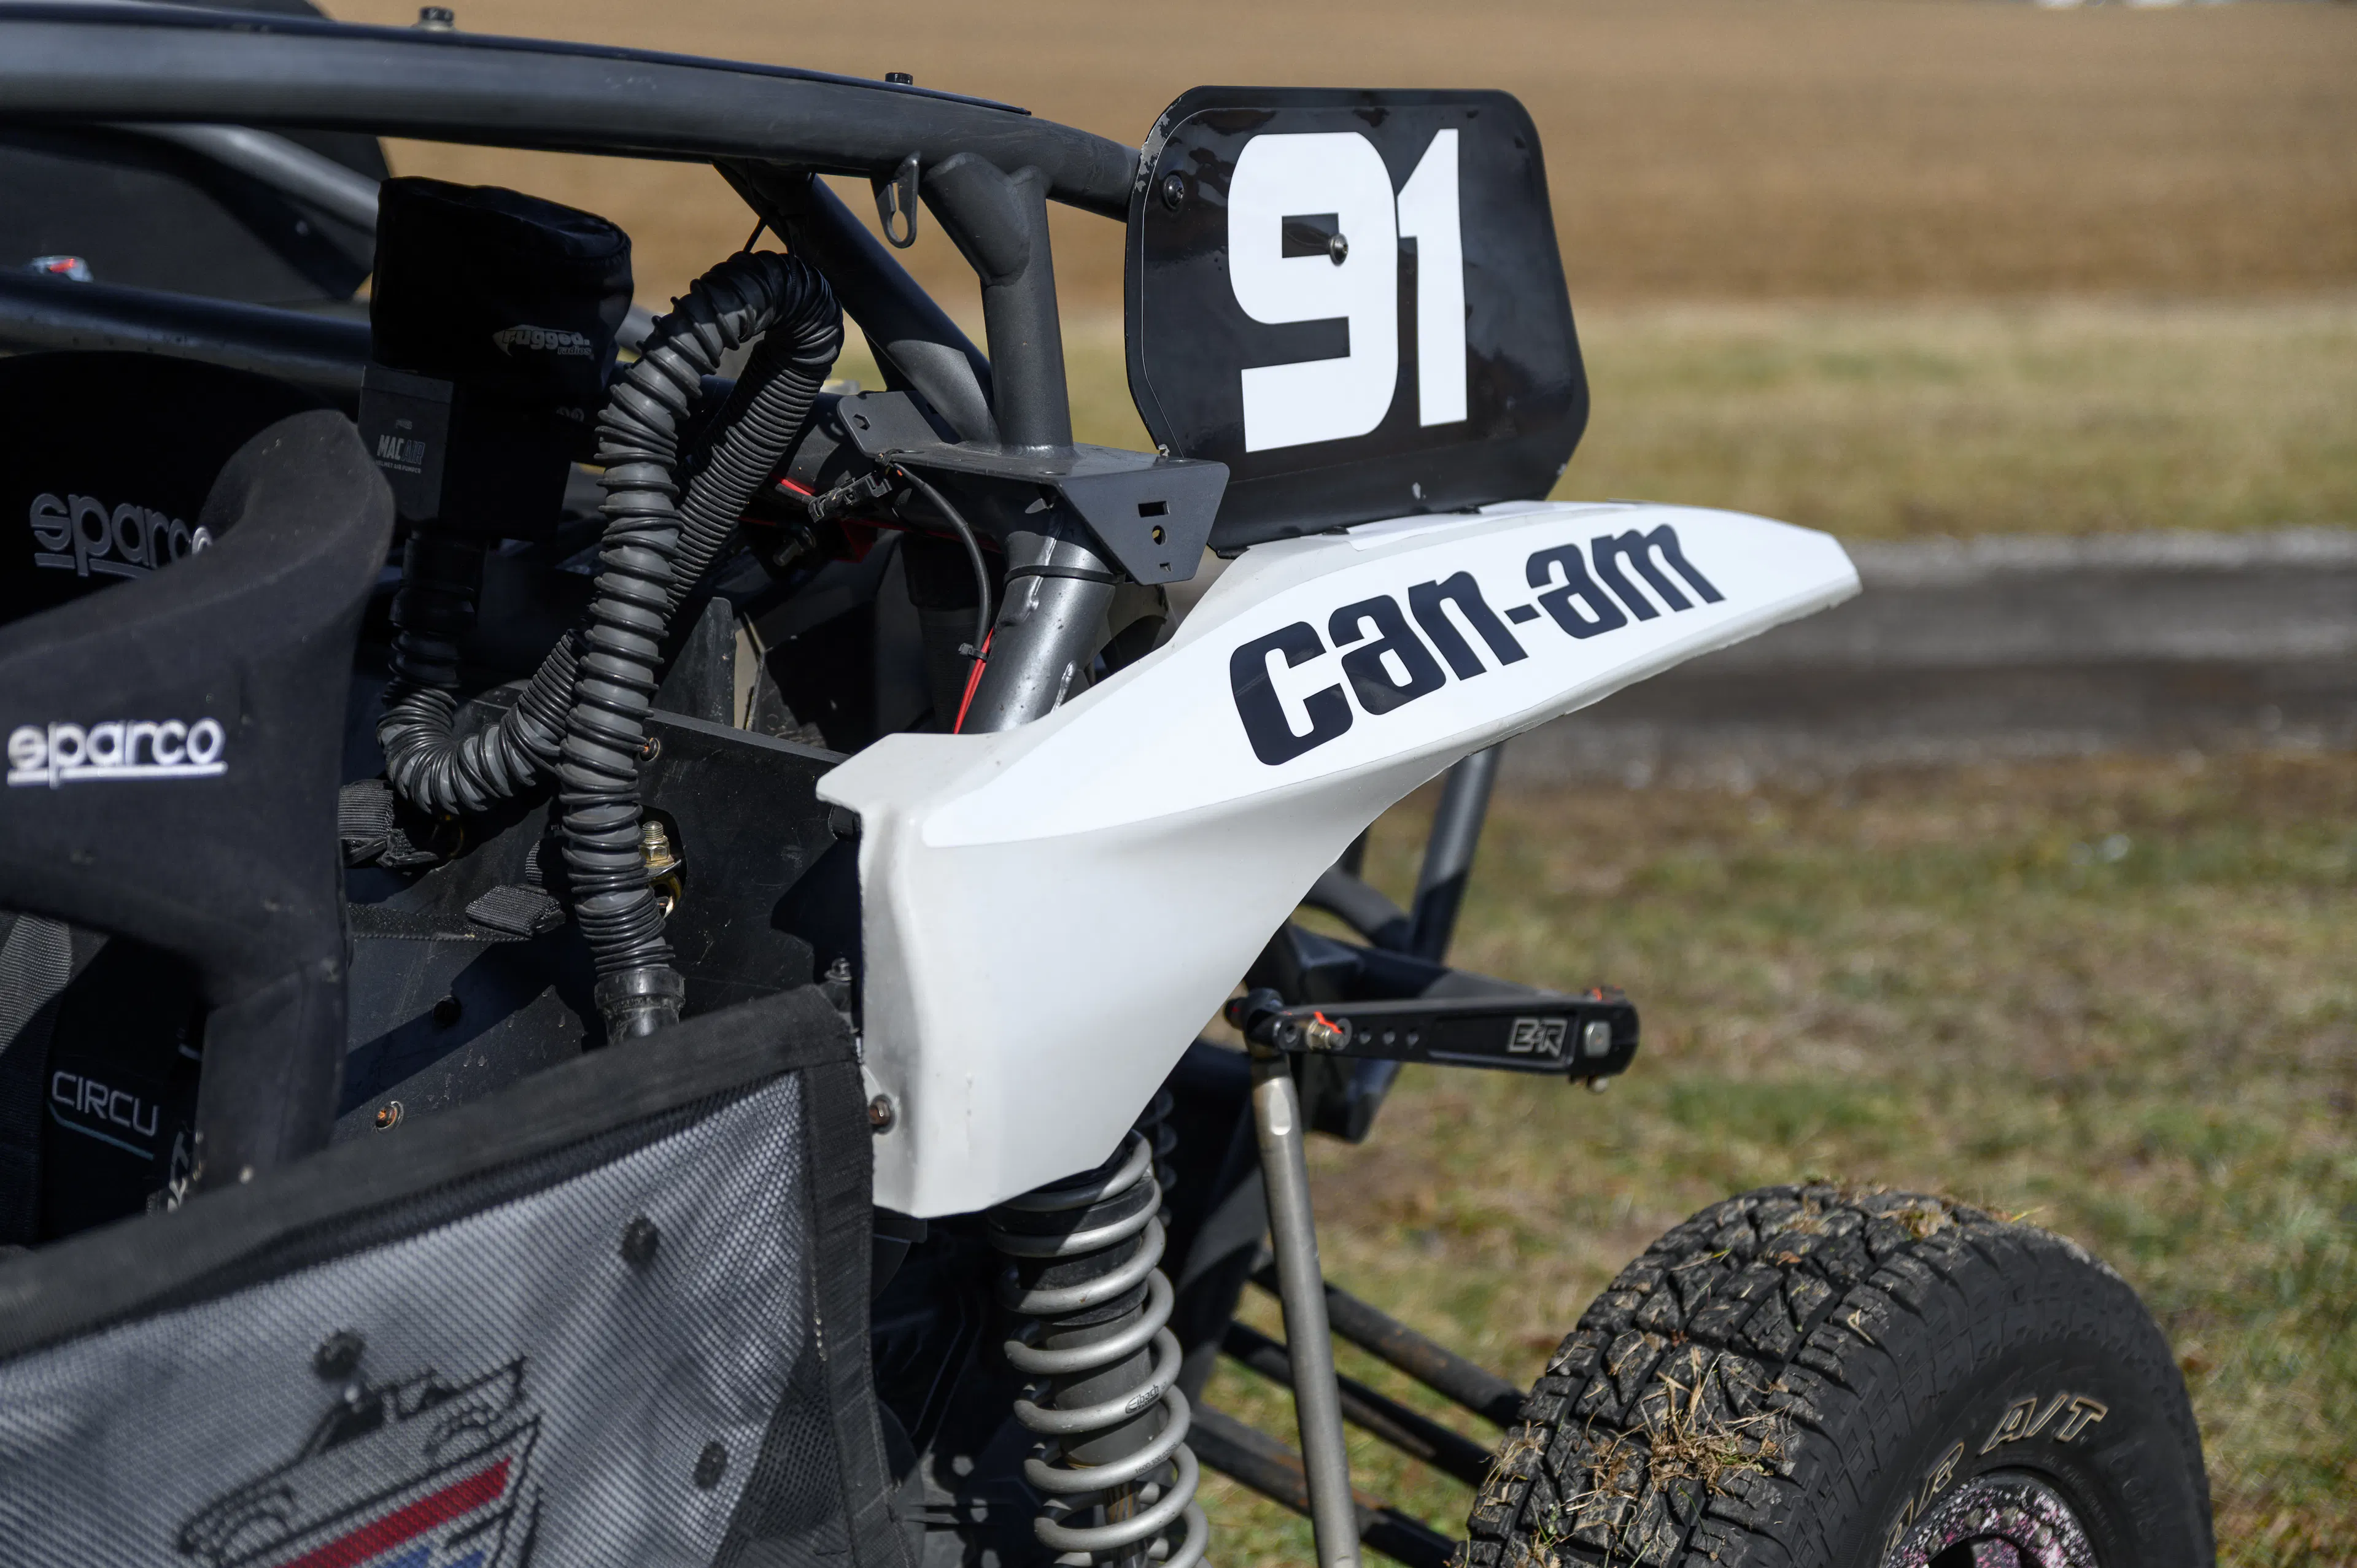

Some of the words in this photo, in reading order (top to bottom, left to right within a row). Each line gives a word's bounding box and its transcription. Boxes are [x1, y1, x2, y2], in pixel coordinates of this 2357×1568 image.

[1227, 128, 1468, 454] 91
[557, 344, 592, 355] radios
[401, 465, 422, 474] PUMPER
[7, 716, 227, 789] sparco
[1125, 1384, 1159, 1414] Eibach
[1975, 1393, 2109, 1457] A/T
